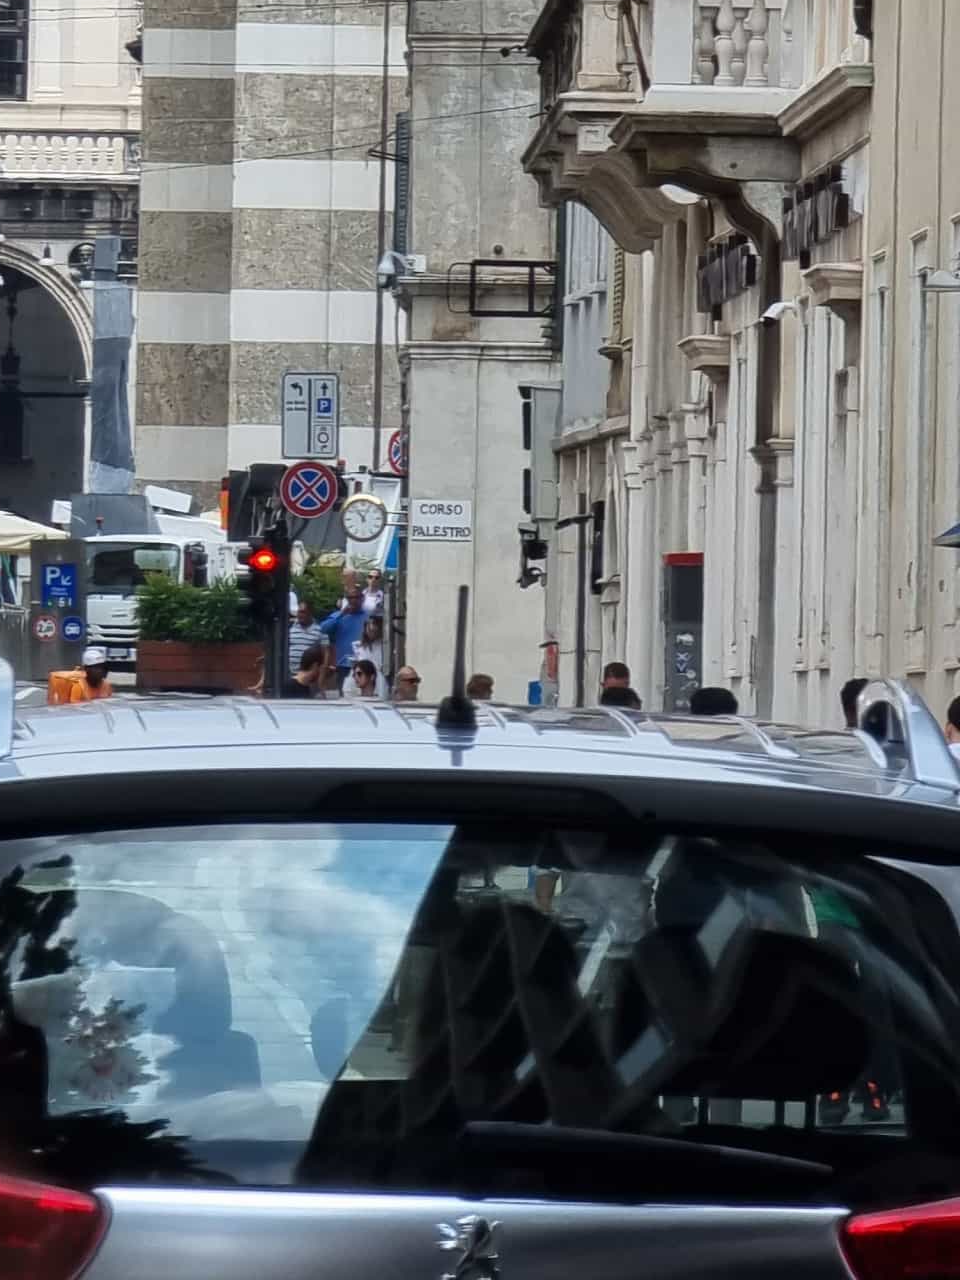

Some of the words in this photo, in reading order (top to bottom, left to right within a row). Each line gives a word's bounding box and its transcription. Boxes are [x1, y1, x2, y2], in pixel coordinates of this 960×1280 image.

[420, 503, 463, 516] CORSO
[412, 525, 471, 537] PALESTRO
[45, 566, 61, 586] P
